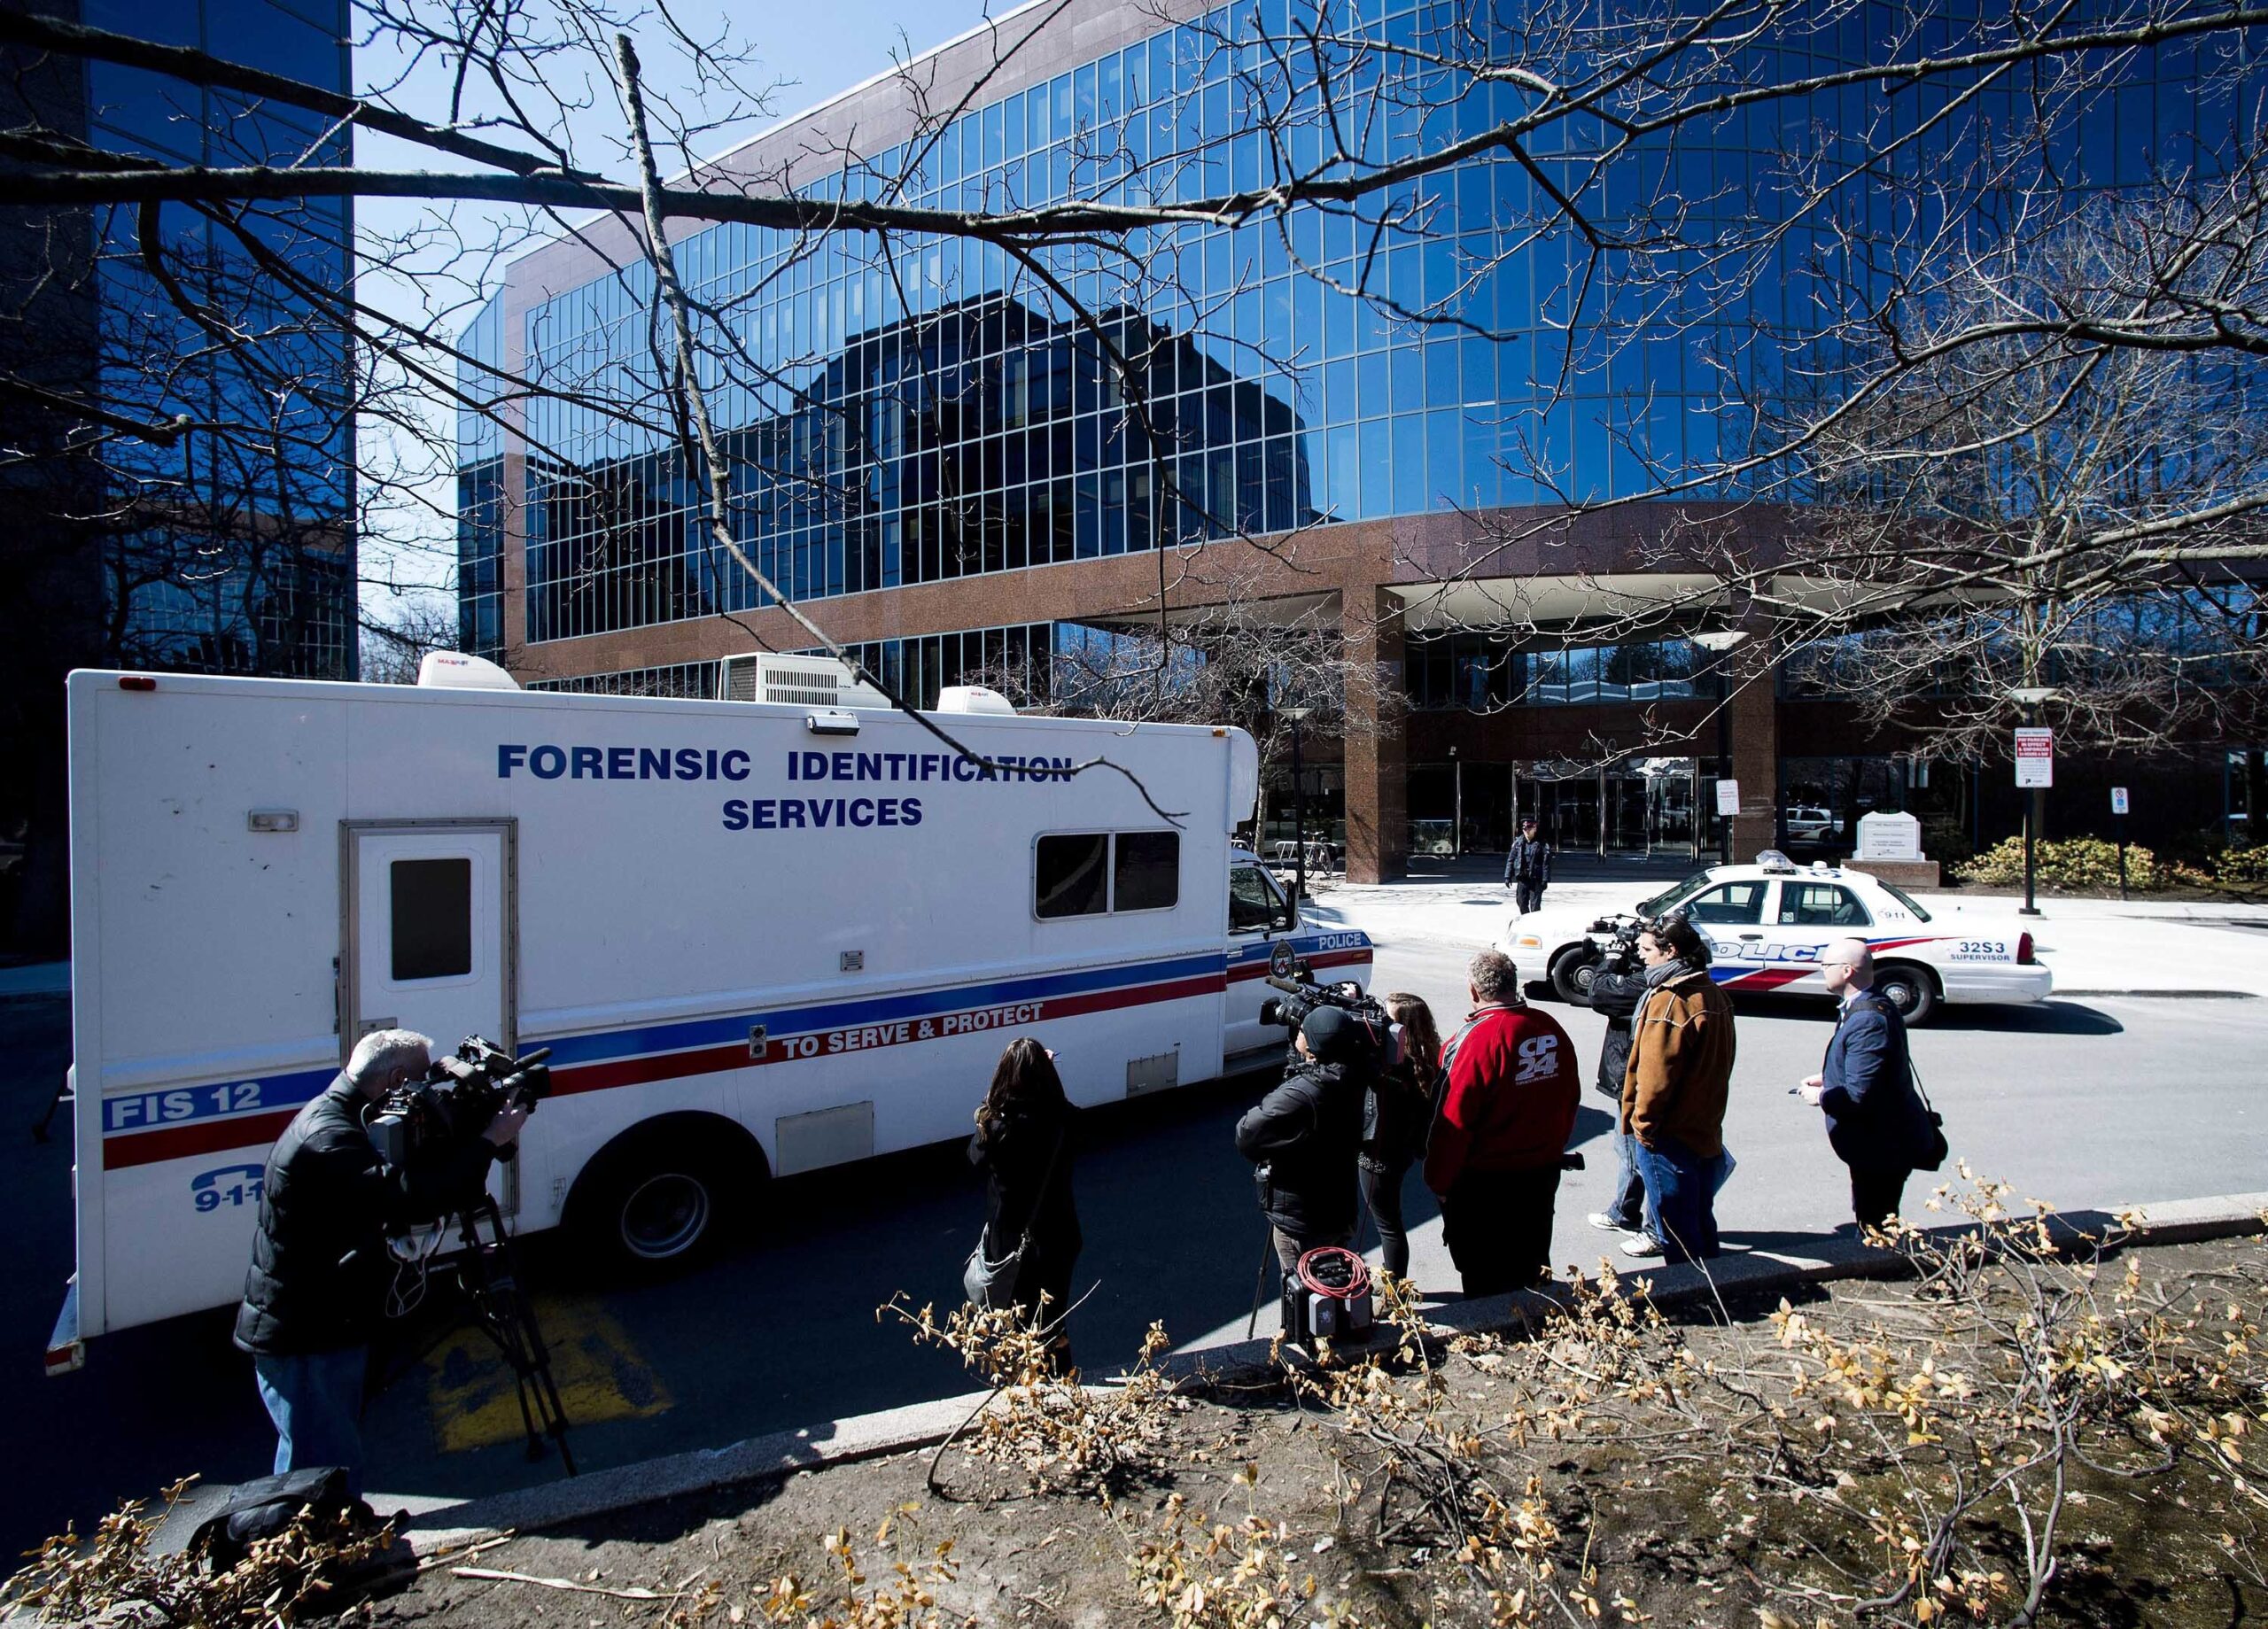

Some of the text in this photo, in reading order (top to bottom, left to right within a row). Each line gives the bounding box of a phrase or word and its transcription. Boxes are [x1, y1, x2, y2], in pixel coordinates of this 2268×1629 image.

[498, 744, 1072, 782] FORENSIC IDENTIFICATION
[722, 797, 922, 831] SERVICES
[1318, 933, 1362, 950] POLICE
[1712, 942, 1829, 962] OLIC
[1960, 942, 2005, 953] 32S3
[782, 1003, 1044, 1059] TO SERVE & PROTECT
[1518, 1035, 1558, 1058] CP
[1515, 1051, 1559, 1082] 24
[112, 1082, 261, 1129] FIS 12
